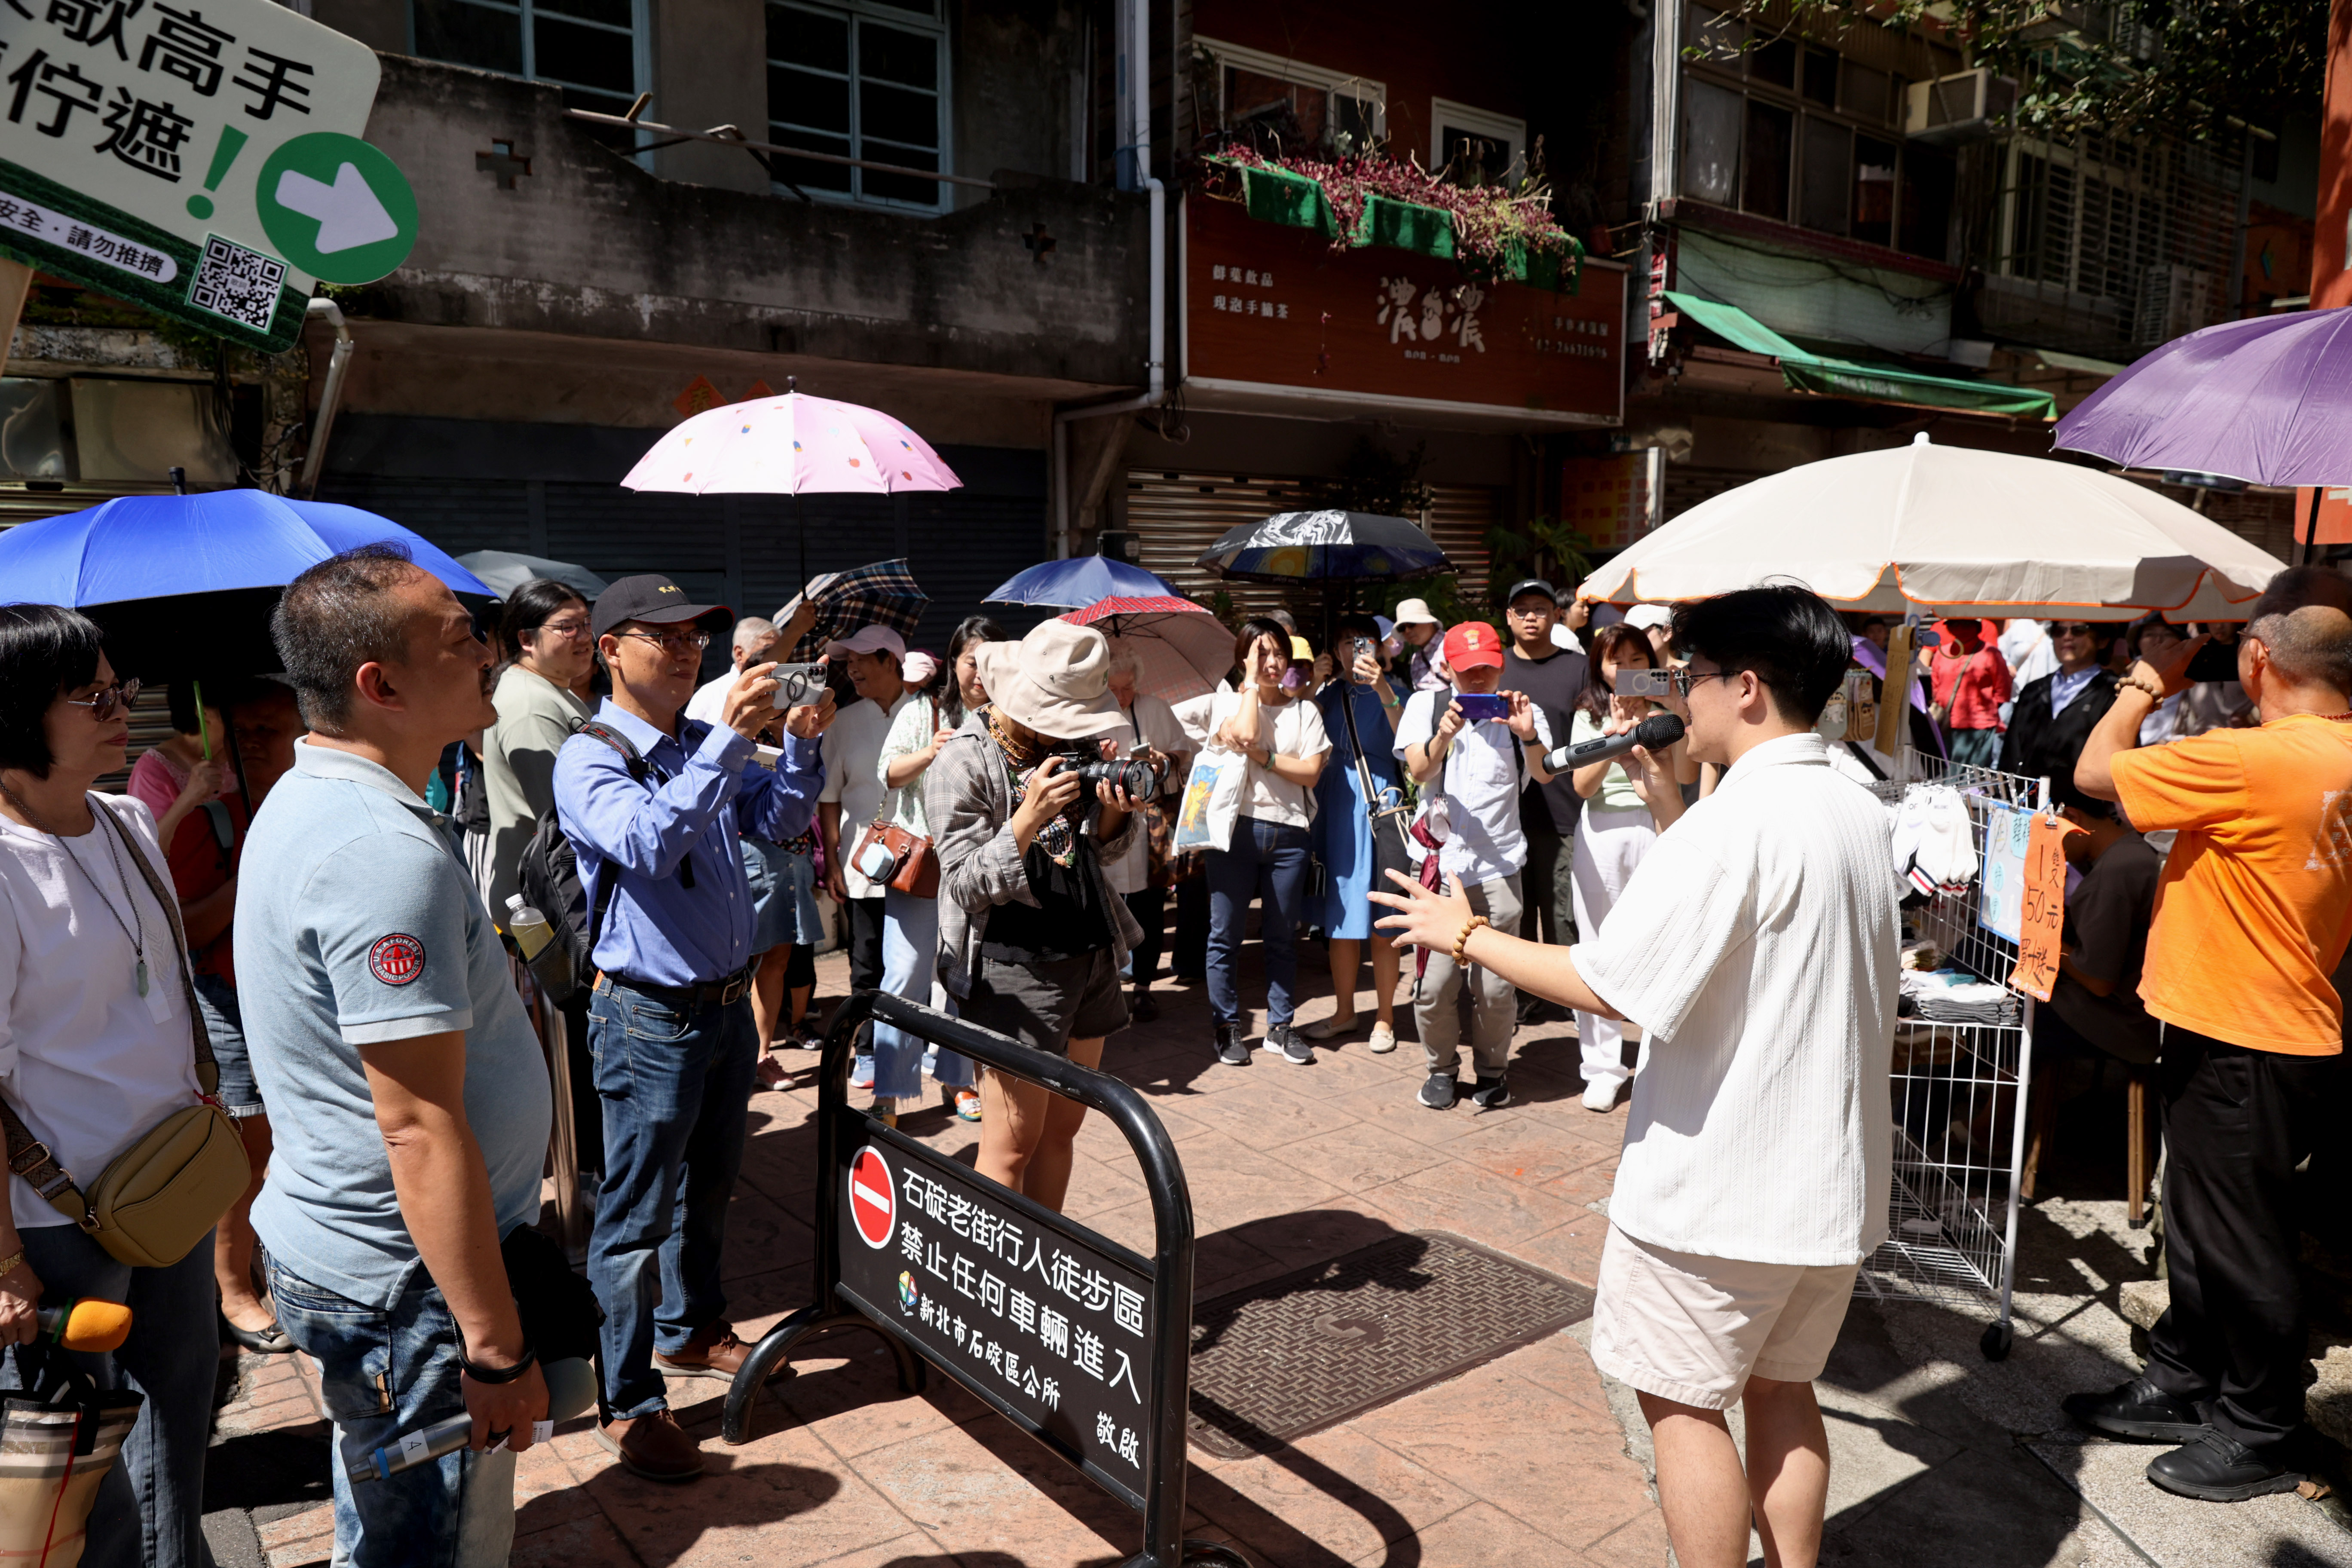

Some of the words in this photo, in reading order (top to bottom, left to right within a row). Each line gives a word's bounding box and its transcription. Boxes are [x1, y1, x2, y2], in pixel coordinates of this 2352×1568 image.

[3, 0, 315, 120] 歌高手
[0, 40, 249, 220] 佇遮!
[689, 385, 711, 414] 春
[390, 937, 420, 956] FOREST
[2025, 885, 2059, 929] 50元
[375, 965, 398, 980] BASIC
[398, 959, 420, 980] POWER
[903, 1167, 1145, 1338] 石碇老街行人徒步區
[901, 1221, 1141, 1404] 禁止任何車輛進入
[920, 1293, 1060, 1412] 新北市石碇區公所
[404, 1441, 422, 1452] A
